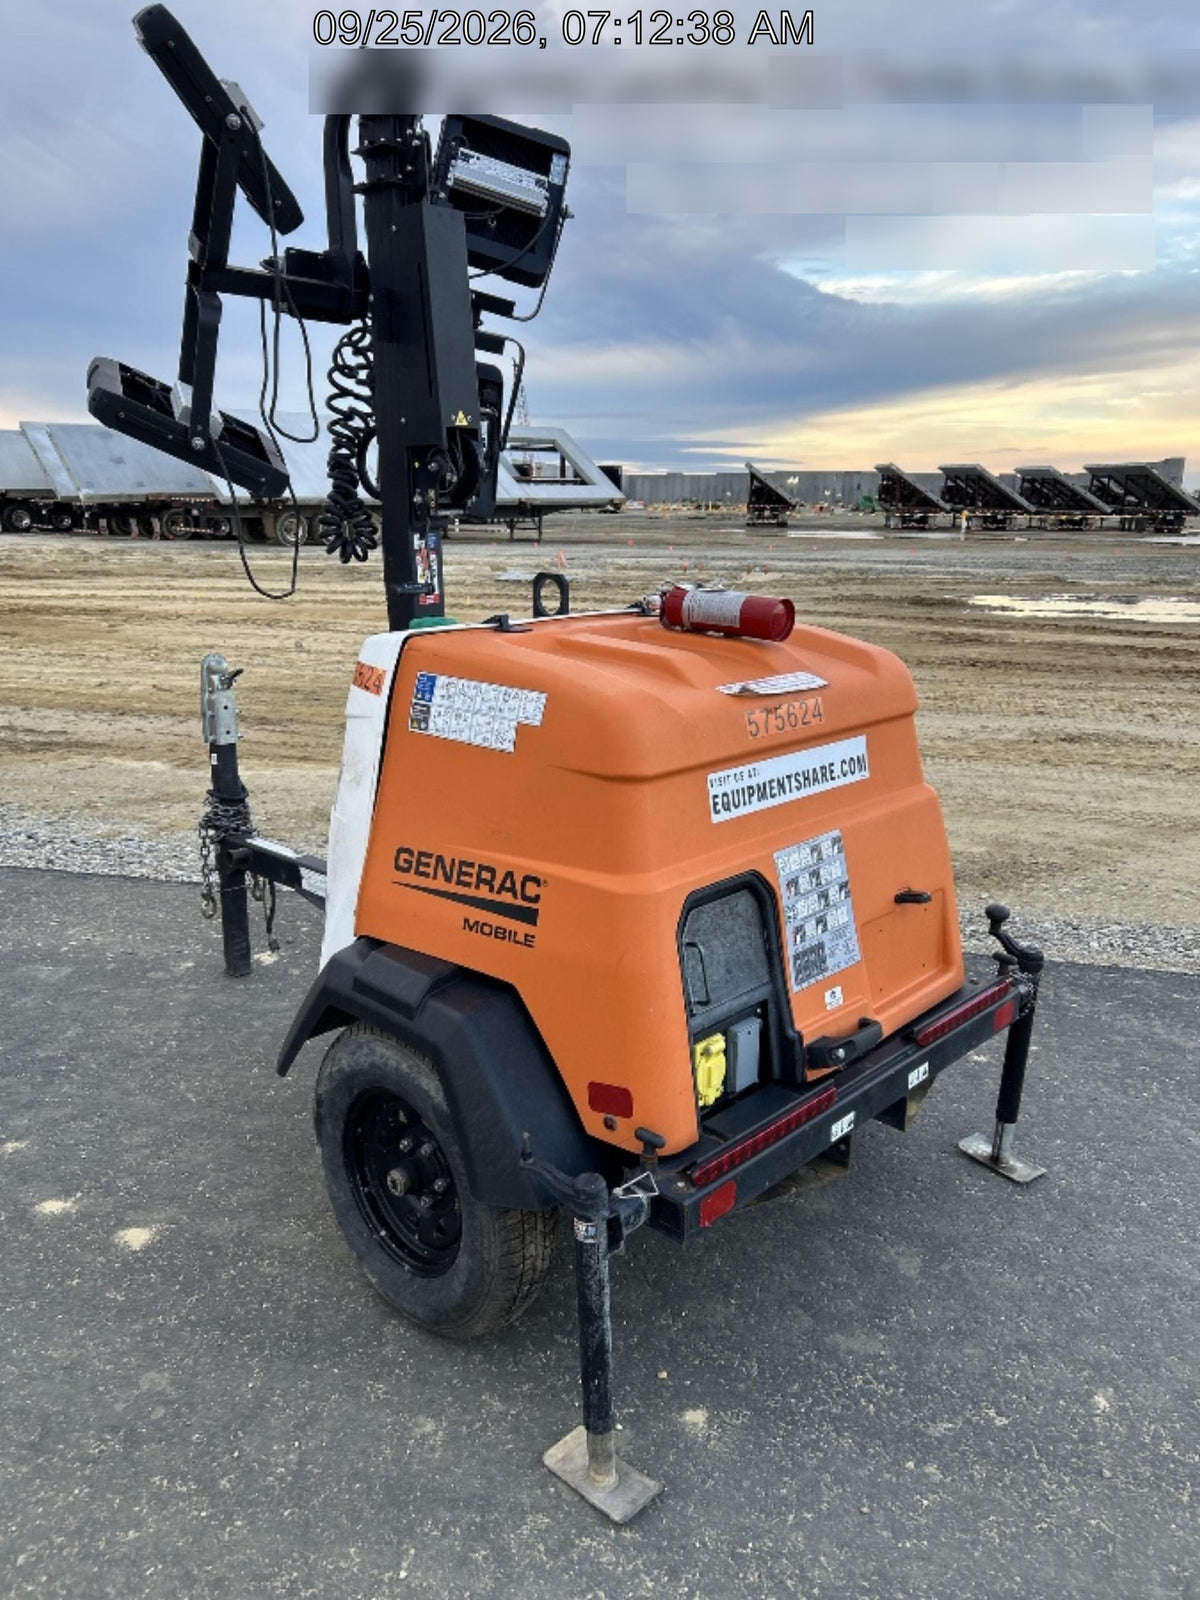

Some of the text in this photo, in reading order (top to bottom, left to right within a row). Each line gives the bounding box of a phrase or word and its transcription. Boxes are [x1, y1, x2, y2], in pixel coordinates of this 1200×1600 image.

[746, 698, 823, 737] 575624
[711, 753, 868, 815] EQUIPMENTSHARE.COM
[394, 846, 542, 904] GENERAC
[461, 917, 536, 948] MOBILE
